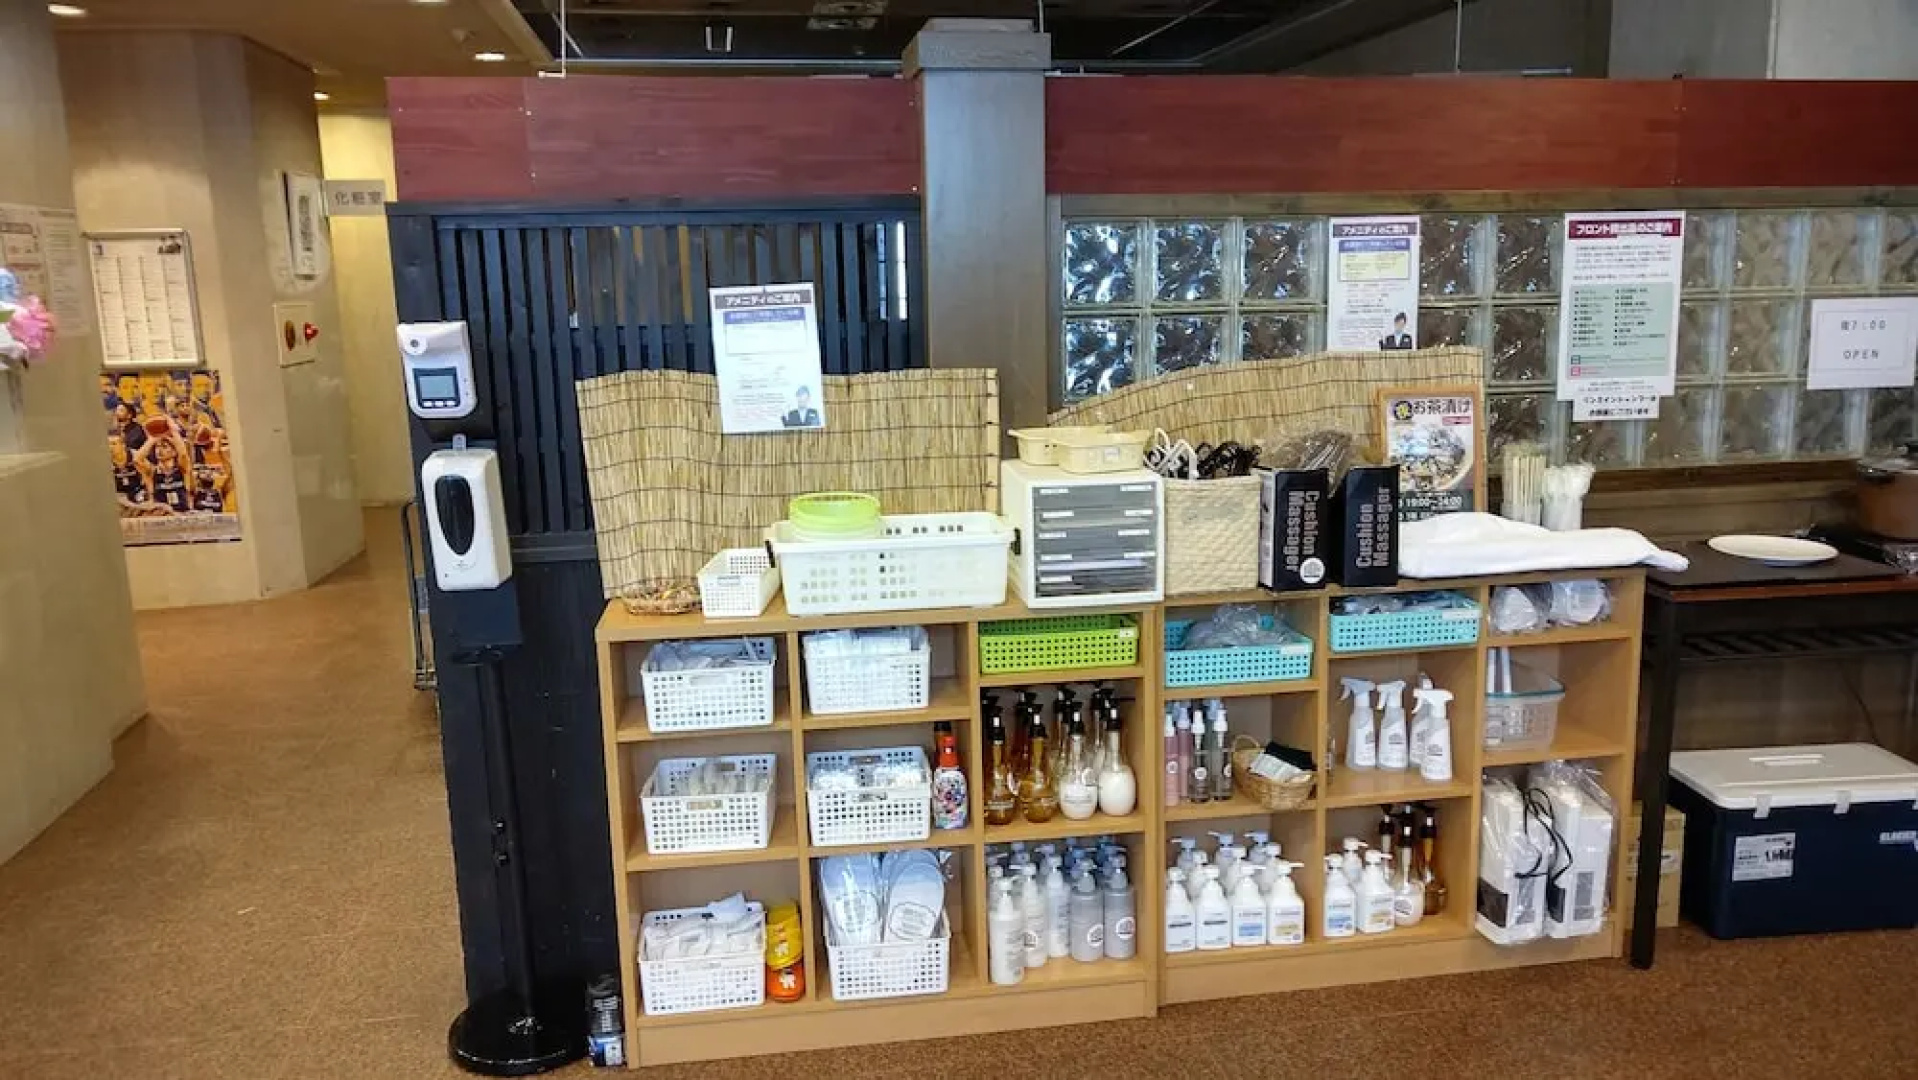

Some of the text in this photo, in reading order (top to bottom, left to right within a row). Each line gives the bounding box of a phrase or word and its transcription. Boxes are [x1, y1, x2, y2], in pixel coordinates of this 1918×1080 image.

[1843, 349, 1879, 359] OPEN
[1413, 398, 1471, 415] お茶漬け
[1283, 490, 1305, 573] Massager
[1302, 491, 1320, 555] Cushion
[1356, 503, 1374, 569] Cushion
[1373, 486, 1393, 567] Massager
